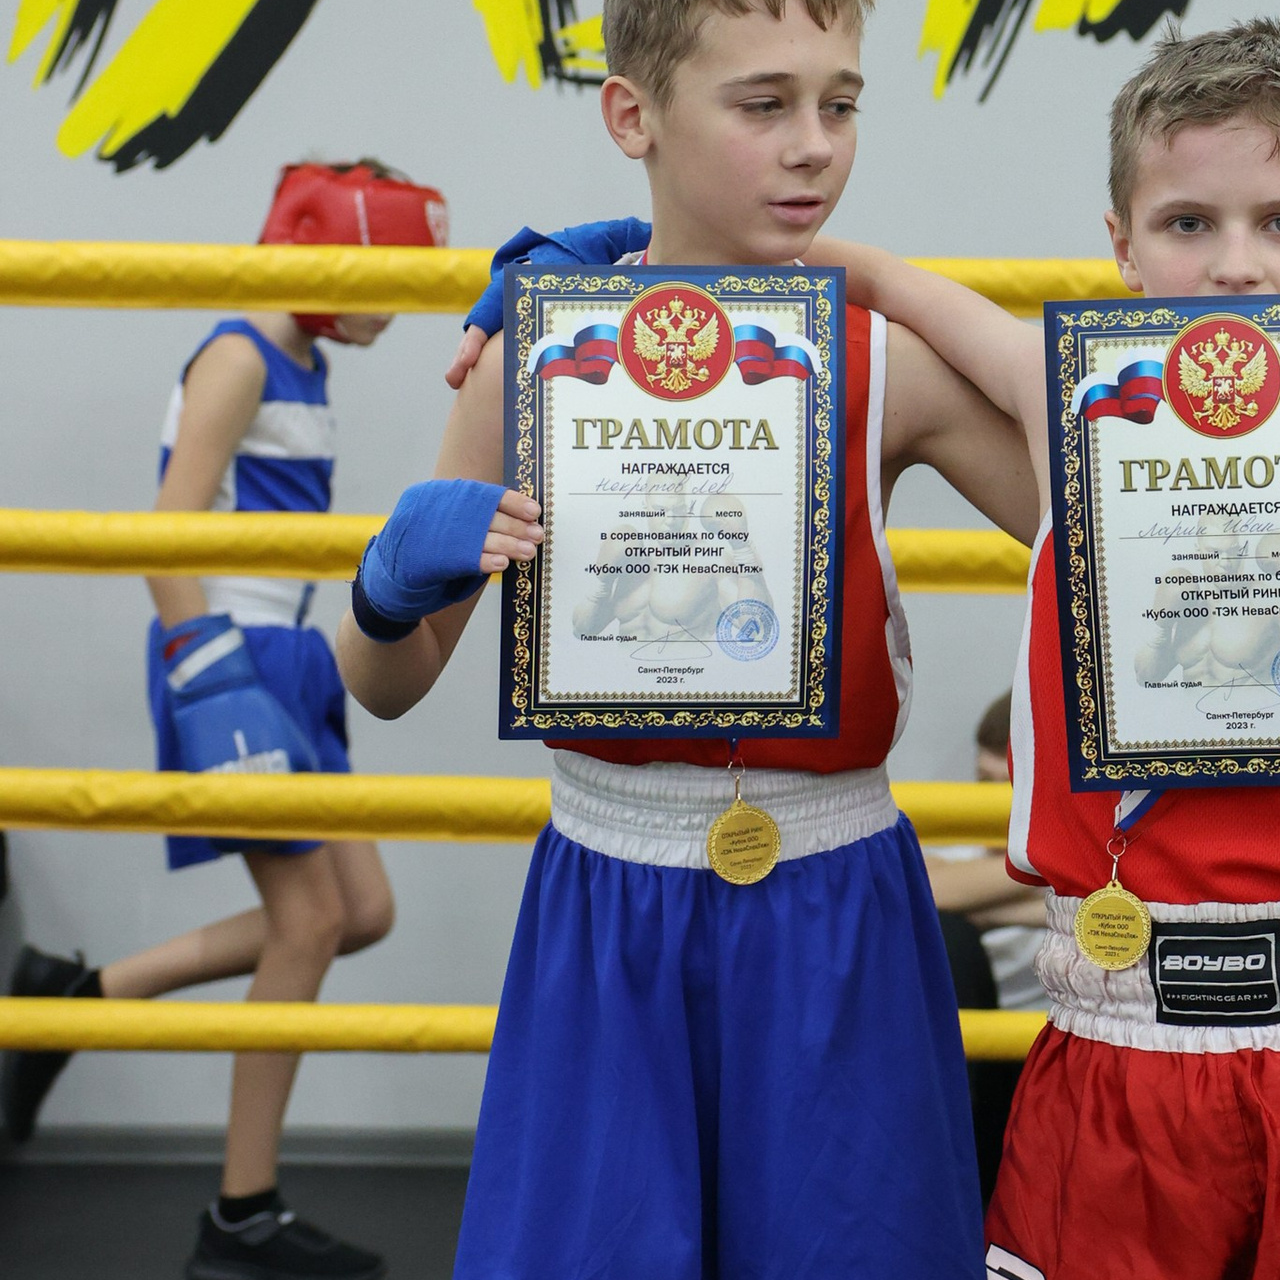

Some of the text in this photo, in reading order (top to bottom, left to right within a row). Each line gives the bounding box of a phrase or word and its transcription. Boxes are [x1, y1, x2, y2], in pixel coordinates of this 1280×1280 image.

[572, 418, 779, 450] ГРАМОТА
[621, 462, 730, 477] НАГРАЖДАЕТСЯ
[618, 508, 666, 518] занявший
[715, 510, 743, 518] место
[610, 532, 698, 542] соревнованиях
[701, 532, 714, 540] по
[717, 530, 749, 542] боксу
[624, 545, 725, 557] ОТКРЫТЫЙ РИНГ
[1171, 551, 1220, 561] занявший
[625, 564, 650, 574] ООО
[1165, 574, 1255, 586] соревнованиях
[1258, 574, 1272, 582] по
[1181, 587, 1249, 601] ОТКРЫТЫЙ
[1183, 607, 1209, 618] ООО
[616, 635, 637, 643] судья
[637, 666, 704, 675] Санкт-Петербург
[1180, 680, 1202, 689] судья
[1206, 711, 1275, 720] Санкт-Петербург
[1226, 722, 1248, 730] 2023
[1161, 954, 1266, 971] BOYBO
